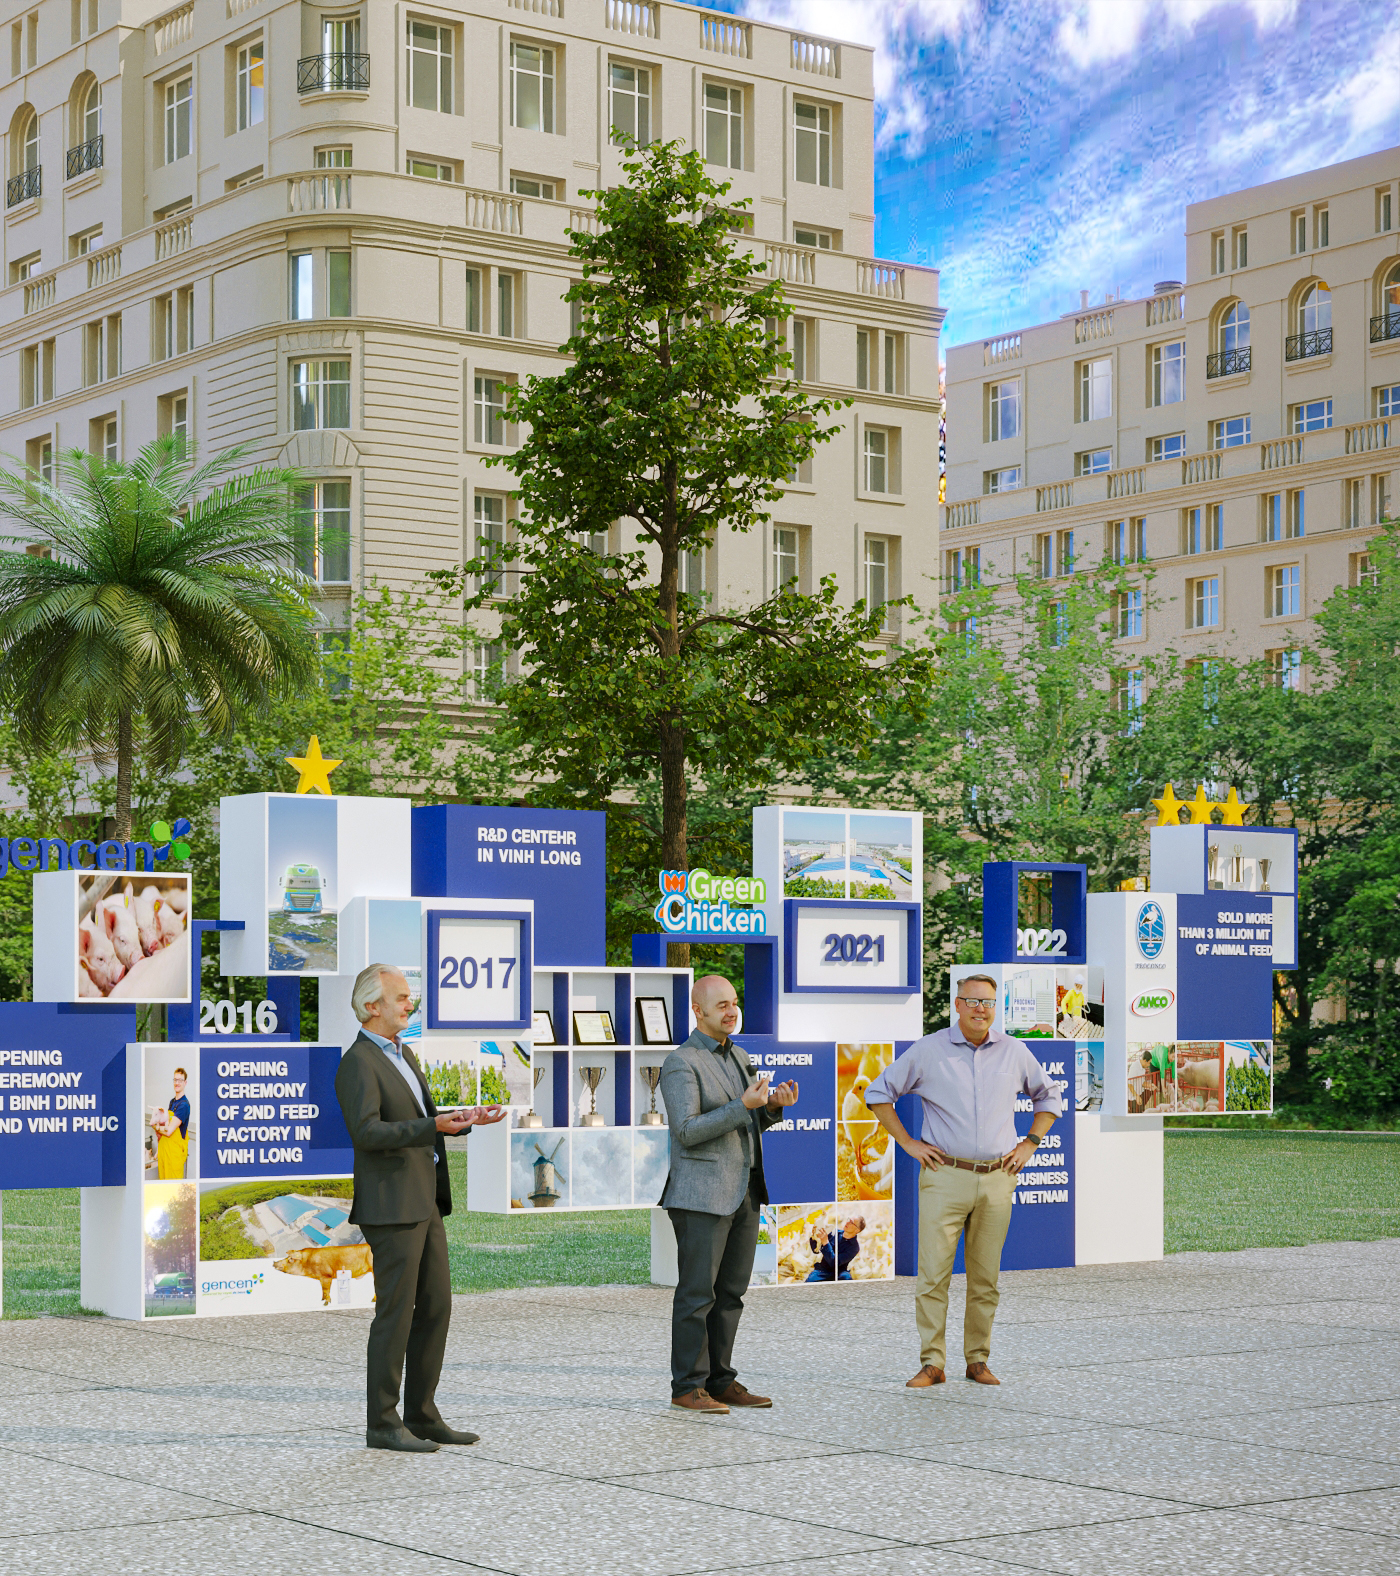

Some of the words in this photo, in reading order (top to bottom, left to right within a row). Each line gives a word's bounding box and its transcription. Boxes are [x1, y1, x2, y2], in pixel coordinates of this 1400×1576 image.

[478, 827, 507, 842] R&D
[512, 829, 576, 845] CENTEHR
[478, 848, 493, 862] IN
[499, 849, 534, 863] VINH
[541, 850, 581, 865] LONG
[691, 871, 764, 900] Green
[663, 894, 765, 933] Chicken
[1218, 912, 1243, 923] SOLD
[1246, 913, 1272, 925] MORE
[1178, 927, 1205, 939] THAN
[1207, 928, 1214, 939] 3
[1215, 928, 1254, 939] MILLION
[1256, 929, 1271, 941] MT
[824, 933, 885, 962] 2021
[1017, 928, 1067, 956] 2022
[1196, 944, 1209, 955] OF
[1211, 944, 1247, 955] ANIMAL
[1249, 945, 1272, 957] FEED
[440, 956, 517, 989] 2017
[1138, 996, 1168, 1008] ANCO
[199, 1000, 278, 1034] 2016
[765, 1054, 812, 1065] CHICKEN
[218, 1061, 288, 1077] OPENING
[218, 1083, 306, 1098] CEREMONY
[10, 1095, 50, 1110] BINH
[56, 1095, 96, 1110] DINH
[218, 1105, 239, 1120] OF
[244, 1105, 275, 1120] 2ND
[280, 1104, 319, 1119] FEED
[28, 1117, 67, 1133] VINH
[73, 1116, 118, 1132] PHUC
[797, 1119, 831, 1130] PLANT
[218, 1126, 291, 1142] FACTORY
[295, 1126, 310, 1140] IN
[1038, 1135, 1061, 1148] EUS
[217, 1149, 254, 1164] VINH
[260, 1147, 302, 1163] LONG
[1025, 1153, 1064, 1167] MASAN
[1016, 1171, 1069, 1185] BUSINESS
[1019, 1190, 1069, 1204] VIETNAM
[202, 1280, 253, 1293] gencen
